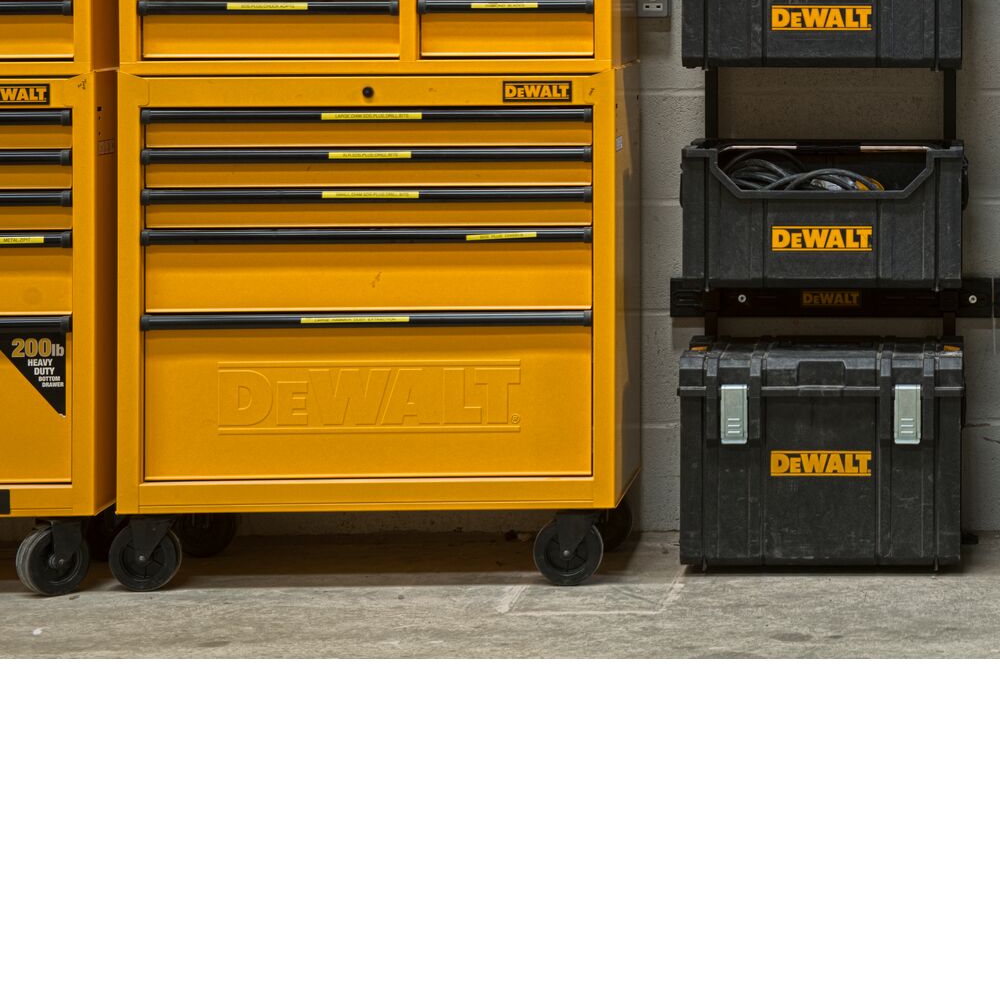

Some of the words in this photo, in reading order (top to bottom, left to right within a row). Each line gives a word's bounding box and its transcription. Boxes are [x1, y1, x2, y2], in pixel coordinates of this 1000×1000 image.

[772, 7, 871, 28] DEWALT
[505, 85, 569, 98] DEWALT
[772, 228, 872, 249] DEWALT
[12, 338, 65, 357] 200lb
[34, 367, 55, 375] DUTY
[218, 368, 520, 426] DEWALT
[771, 453, 871, 474] DEWALT
